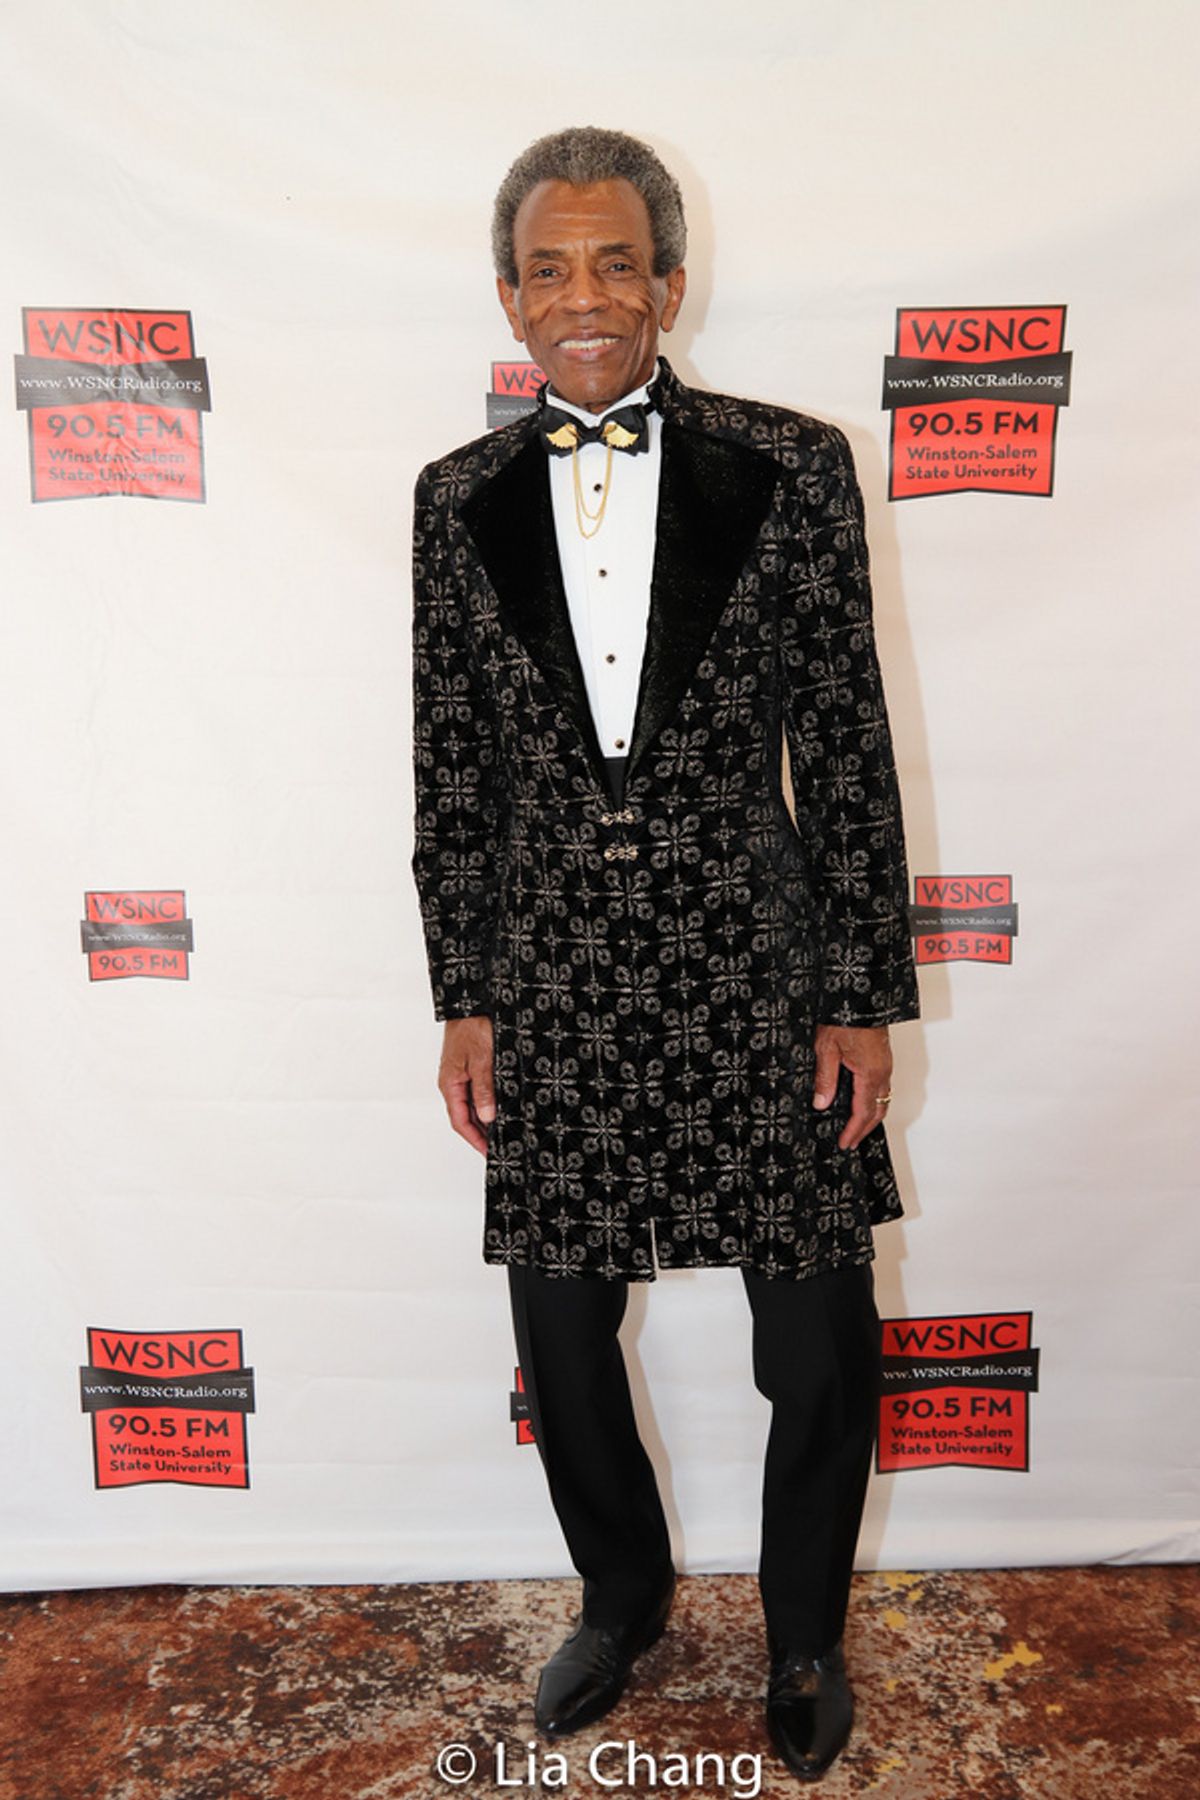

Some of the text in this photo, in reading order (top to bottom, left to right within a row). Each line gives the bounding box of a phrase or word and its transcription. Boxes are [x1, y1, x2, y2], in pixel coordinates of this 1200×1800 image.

[37, 319, 180, 355] WSNC
[911, 317, 1050, 352] WSNC
[20, 376, 203, 393] www.WSNCRadio.org
[500, 368, 543, 392] WS
[887, 373, 1064, 389] www.WSNCRadio.org
[47, 414, 184, 439] 90.5 FM
[909, 411, 1039, 436] 90.5 FM
[48, 448, 185, 464] Winston-Salem
[907, 443, 1037, 460] Winston-Salem
[48, 467, 186, 485] State University
[906, 464, 1037, 480] State University
[923, 882, 1004, 903] WSNC
[92, 897, 177, 919] WSNC
[925, 939, 1002, 954] 90.5 FM
[99, 954, 178, 971] 90.5 FM
[892, 1322, 1019, 1352] WSNC
[101, 1338, 229, 1369] WSNC
[882, 1365, 1033, 1380] ww.WSNCRadio.org
[84, 1384, 248, 1399] www.WSNCRadio.org
[892, 1396, 1012, 1419] 90.5 FM
[108, 1414, 229, 1438] 90.5 FM
[891, 1425, 1013, 1440] Winston-Salem
[110, 1443, 231, 1458] Winston-Salem
[891, 1441, 1013, 1456] State University
[109, 1460, 232, 1474] State University
